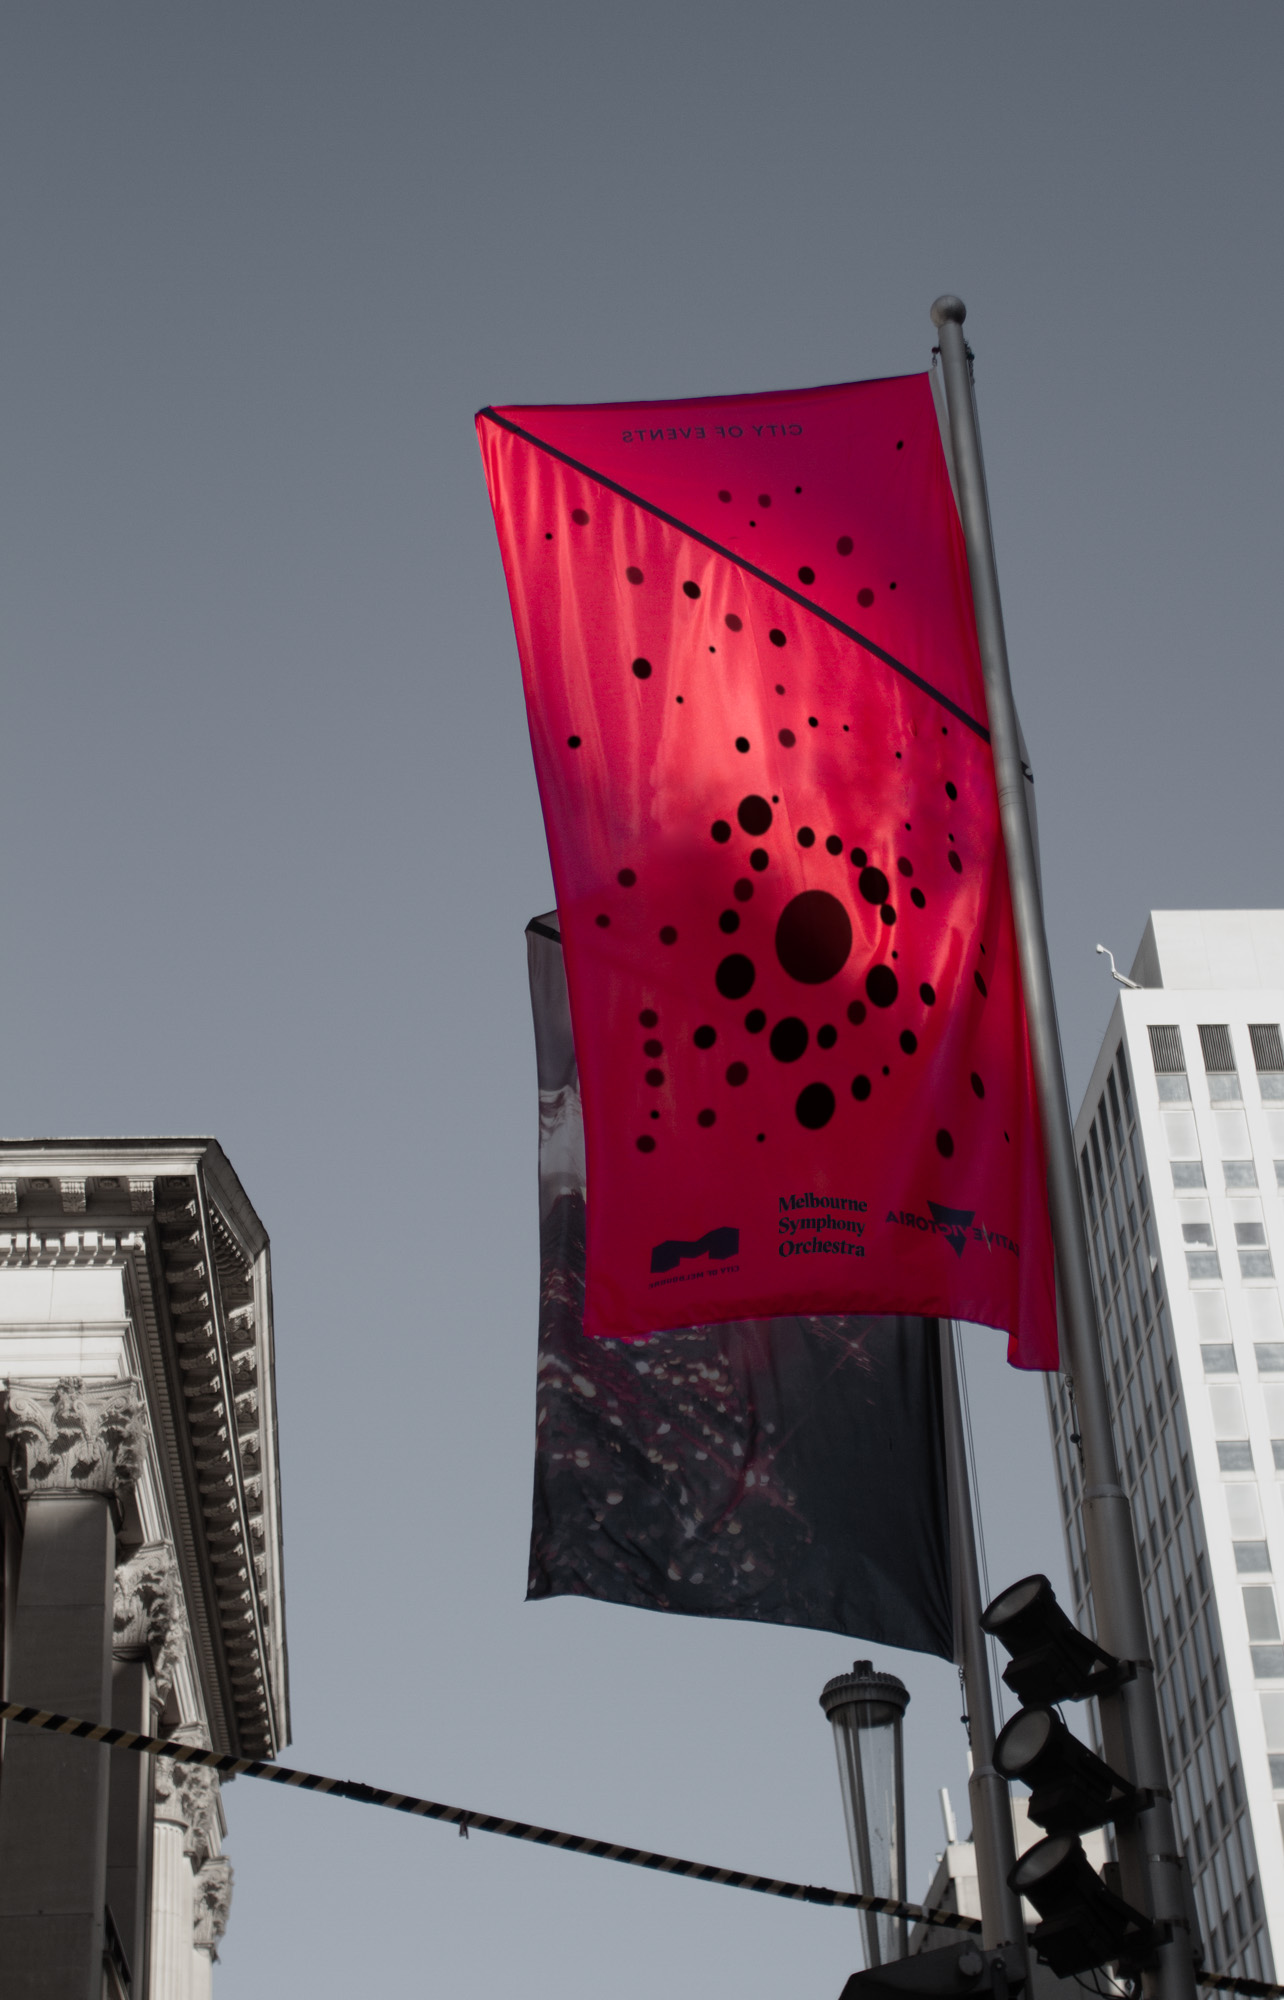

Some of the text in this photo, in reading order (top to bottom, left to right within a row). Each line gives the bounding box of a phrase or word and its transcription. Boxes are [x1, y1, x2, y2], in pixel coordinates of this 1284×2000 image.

[779, 1192, 868, 1213] Melbourne
[779, 1214, 866, 1238] Symphony
[779, 1236, 866, 1258] Orchestra
